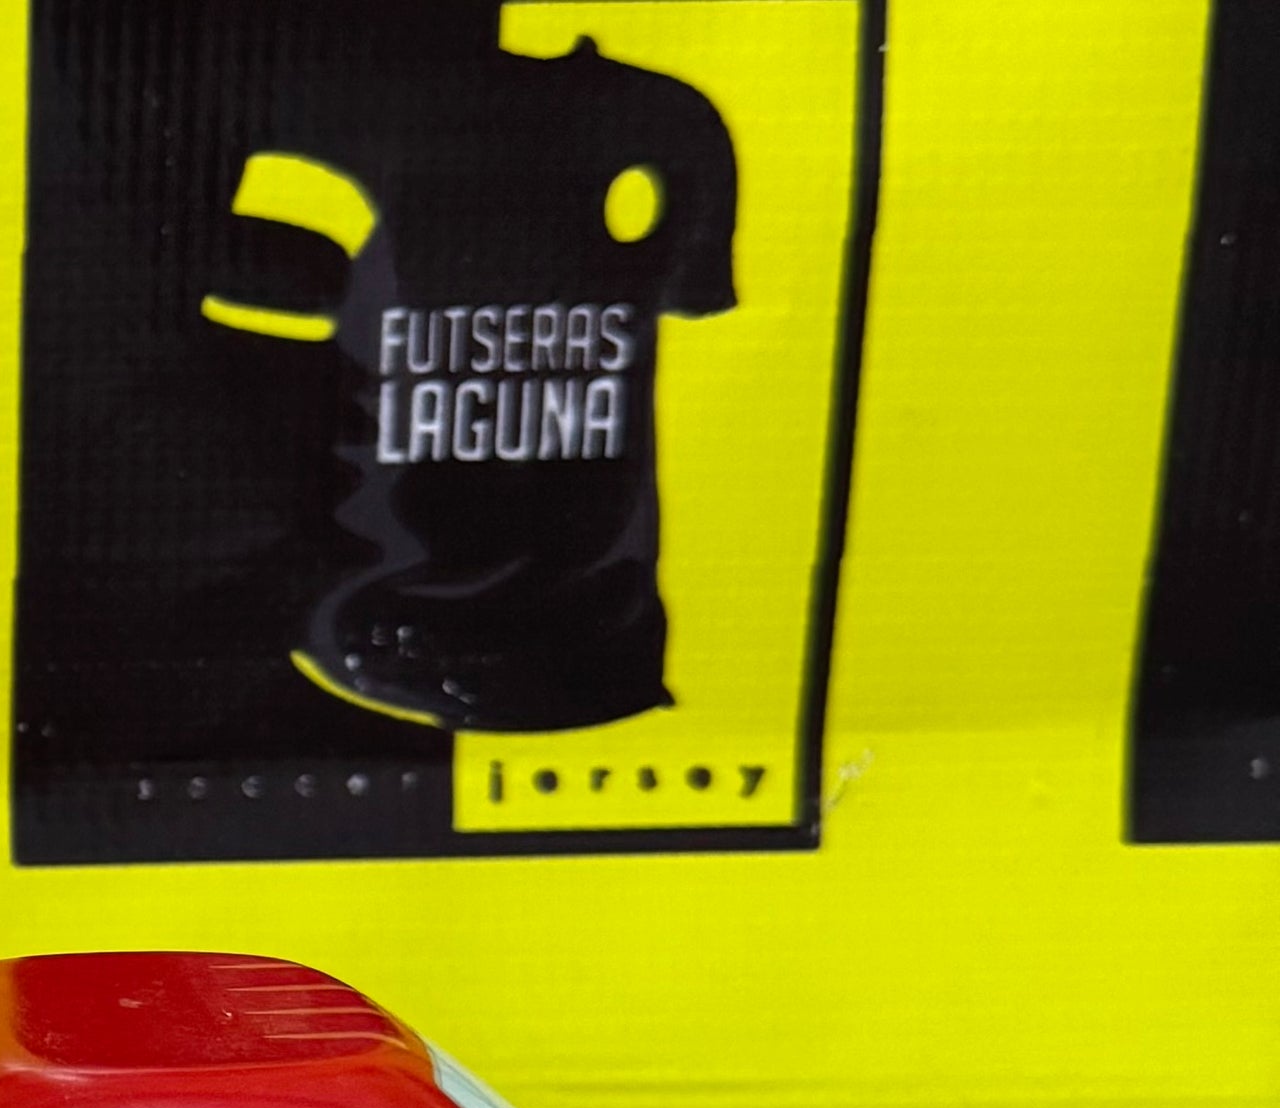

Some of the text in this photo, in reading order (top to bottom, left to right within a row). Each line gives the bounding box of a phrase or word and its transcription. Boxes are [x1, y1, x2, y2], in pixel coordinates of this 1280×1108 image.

[380, 303, 633, 375] FUTSERAS
[377, 376, 623, 464] LAGUNA
[488, 758, 767, 804] jersey
